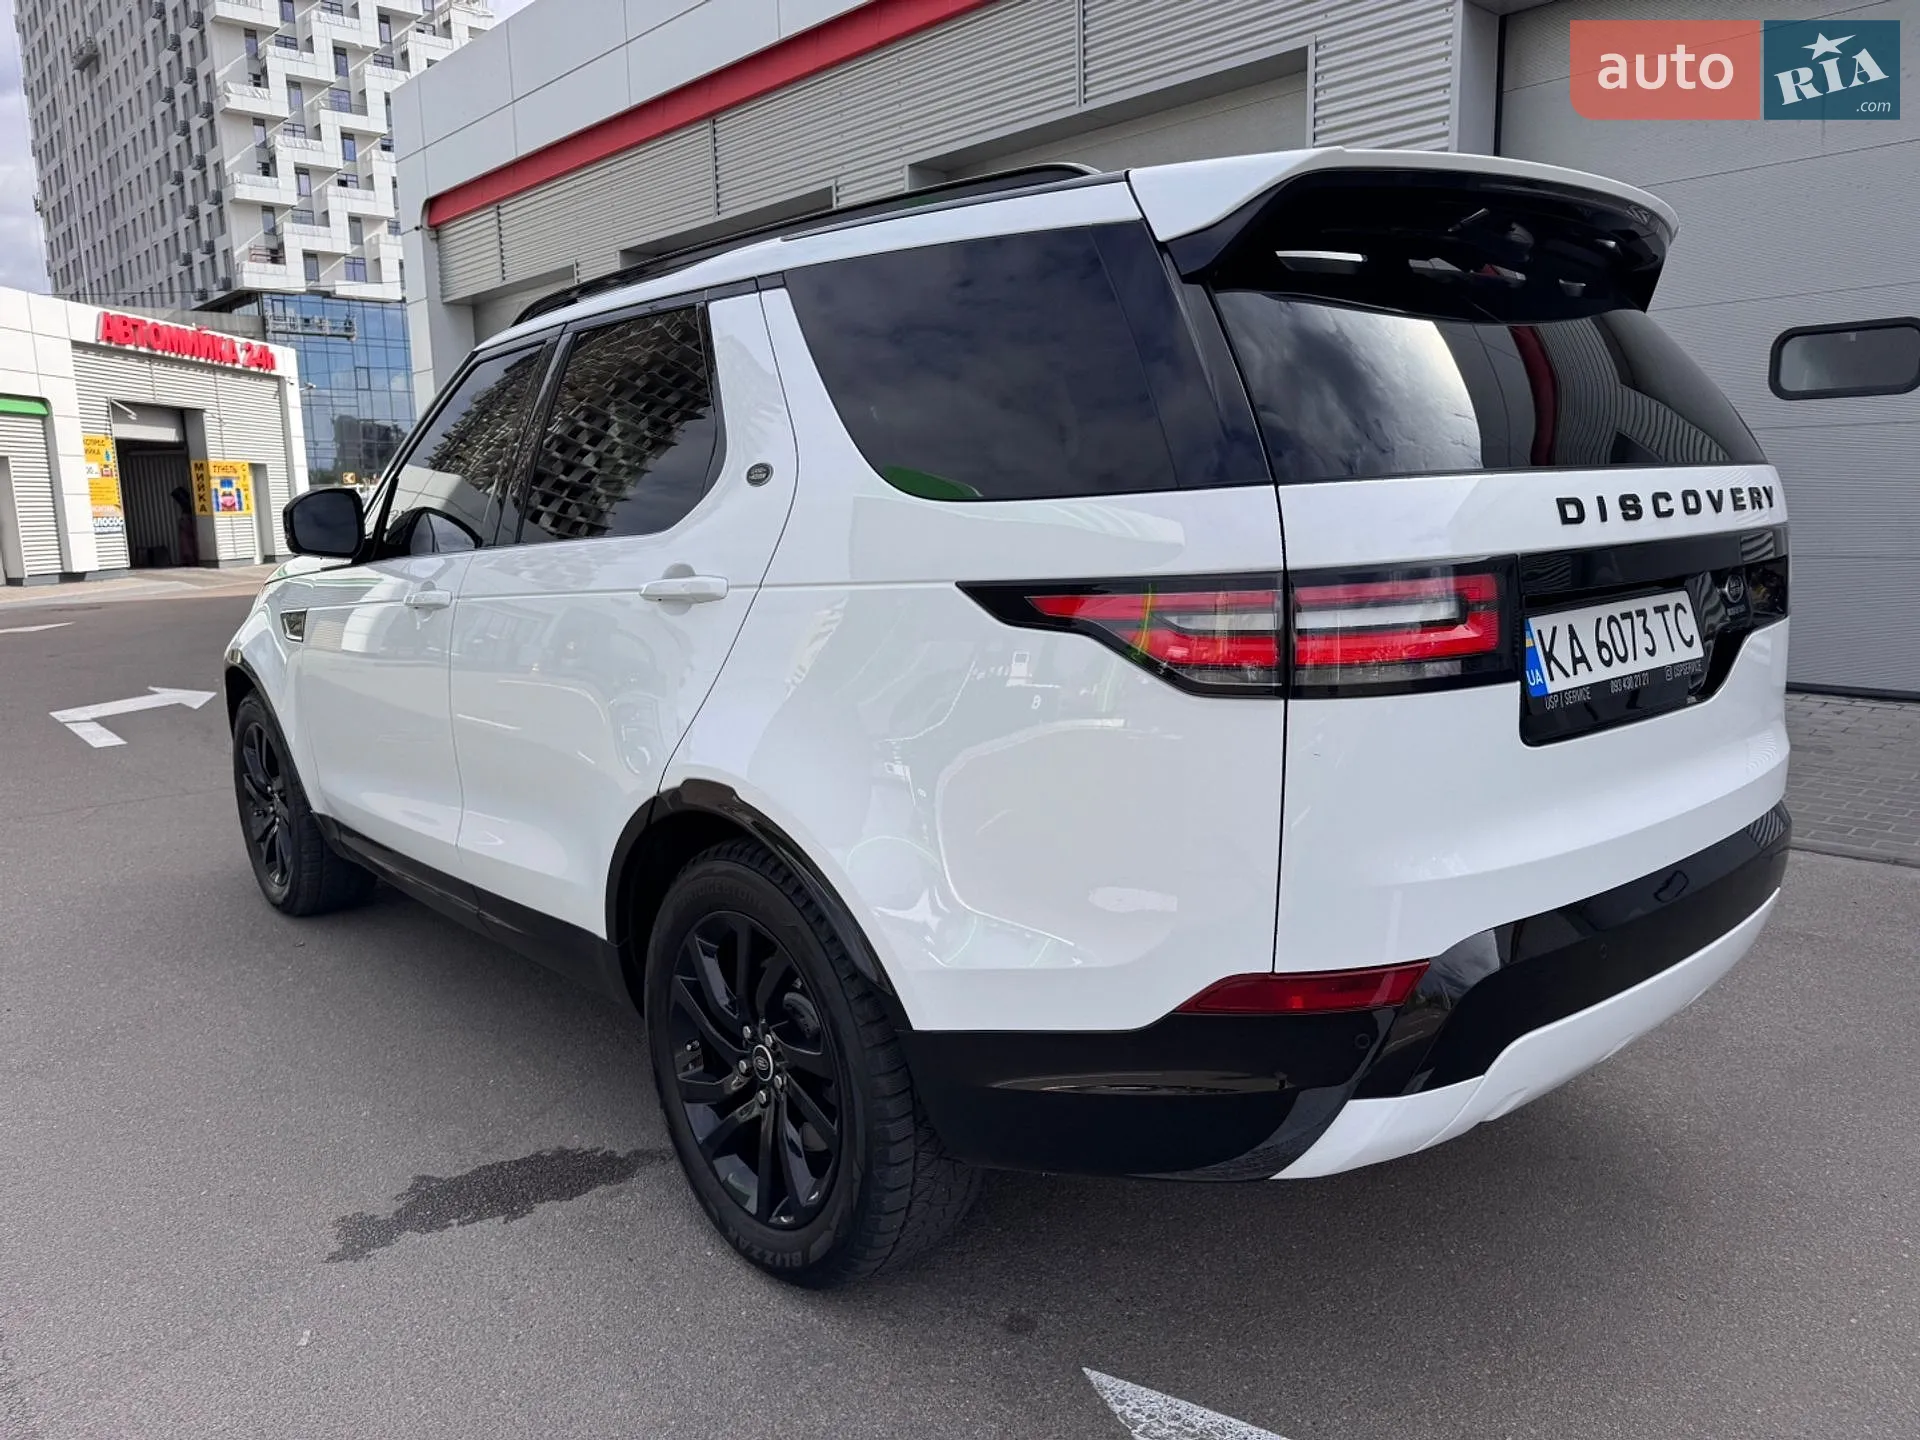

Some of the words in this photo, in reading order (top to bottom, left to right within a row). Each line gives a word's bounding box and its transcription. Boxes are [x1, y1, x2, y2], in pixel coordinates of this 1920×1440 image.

[98, 311, 239, 364] АВТОМИЙКА
[1556, 486, 1774, 525] DISCOVERY
[1537, 623, 1593, 681] KA
[1594, 608, 1656, 668] 6073
[1653, 603, 1694, 652] TC
[1525, 669, 1544, 686] UA
[1564, 686, 1592, 706] SERVICE
